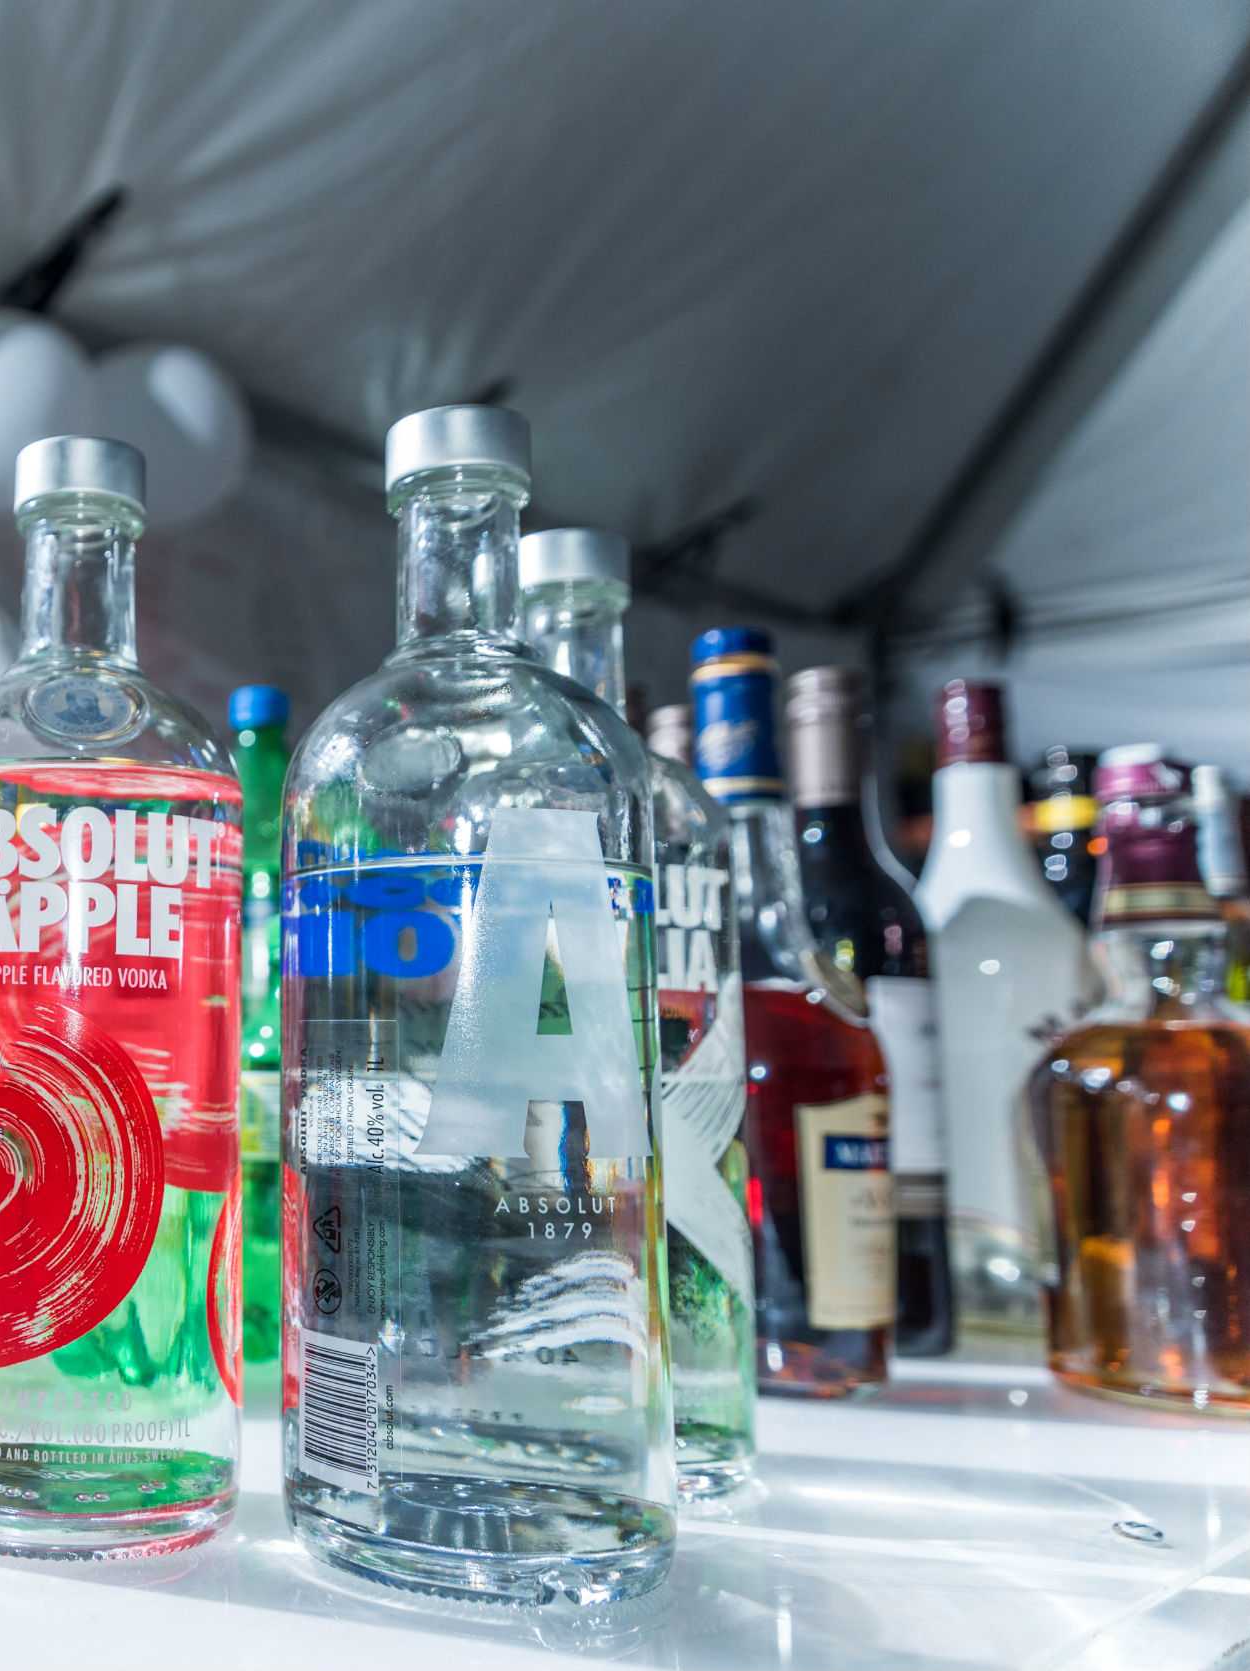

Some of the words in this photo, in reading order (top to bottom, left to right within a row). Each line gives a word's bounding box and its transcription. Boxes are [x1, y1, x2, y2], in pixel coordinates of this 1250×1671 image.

[33, 965, 112, 988] FLAVORED
[118, 967, 167, 990] VODKA
[300, 1047, 308, 1099] VODKA
[366, 1056, 385, 1073] 1L
[366, 1084, 385, 1111] vol.
[300, 1110, 308, 1175] ABSOLUT
[366, 1113, 385, 1147] 40%
[366, 1148, 385, 1175] Alc.
[495, 1197, 615, 1215] ABSOLUT
[528, 1222, 593, 1239] 1879
[367, 1363, 377, 1415] 017034
[385, 1384, 394, 1451] absolut.com
[6, 1447, 29, 1461] AND
[33, 1450, 88, 1464] BOTTLED
[367, 1420, 377, 1472] 312040
